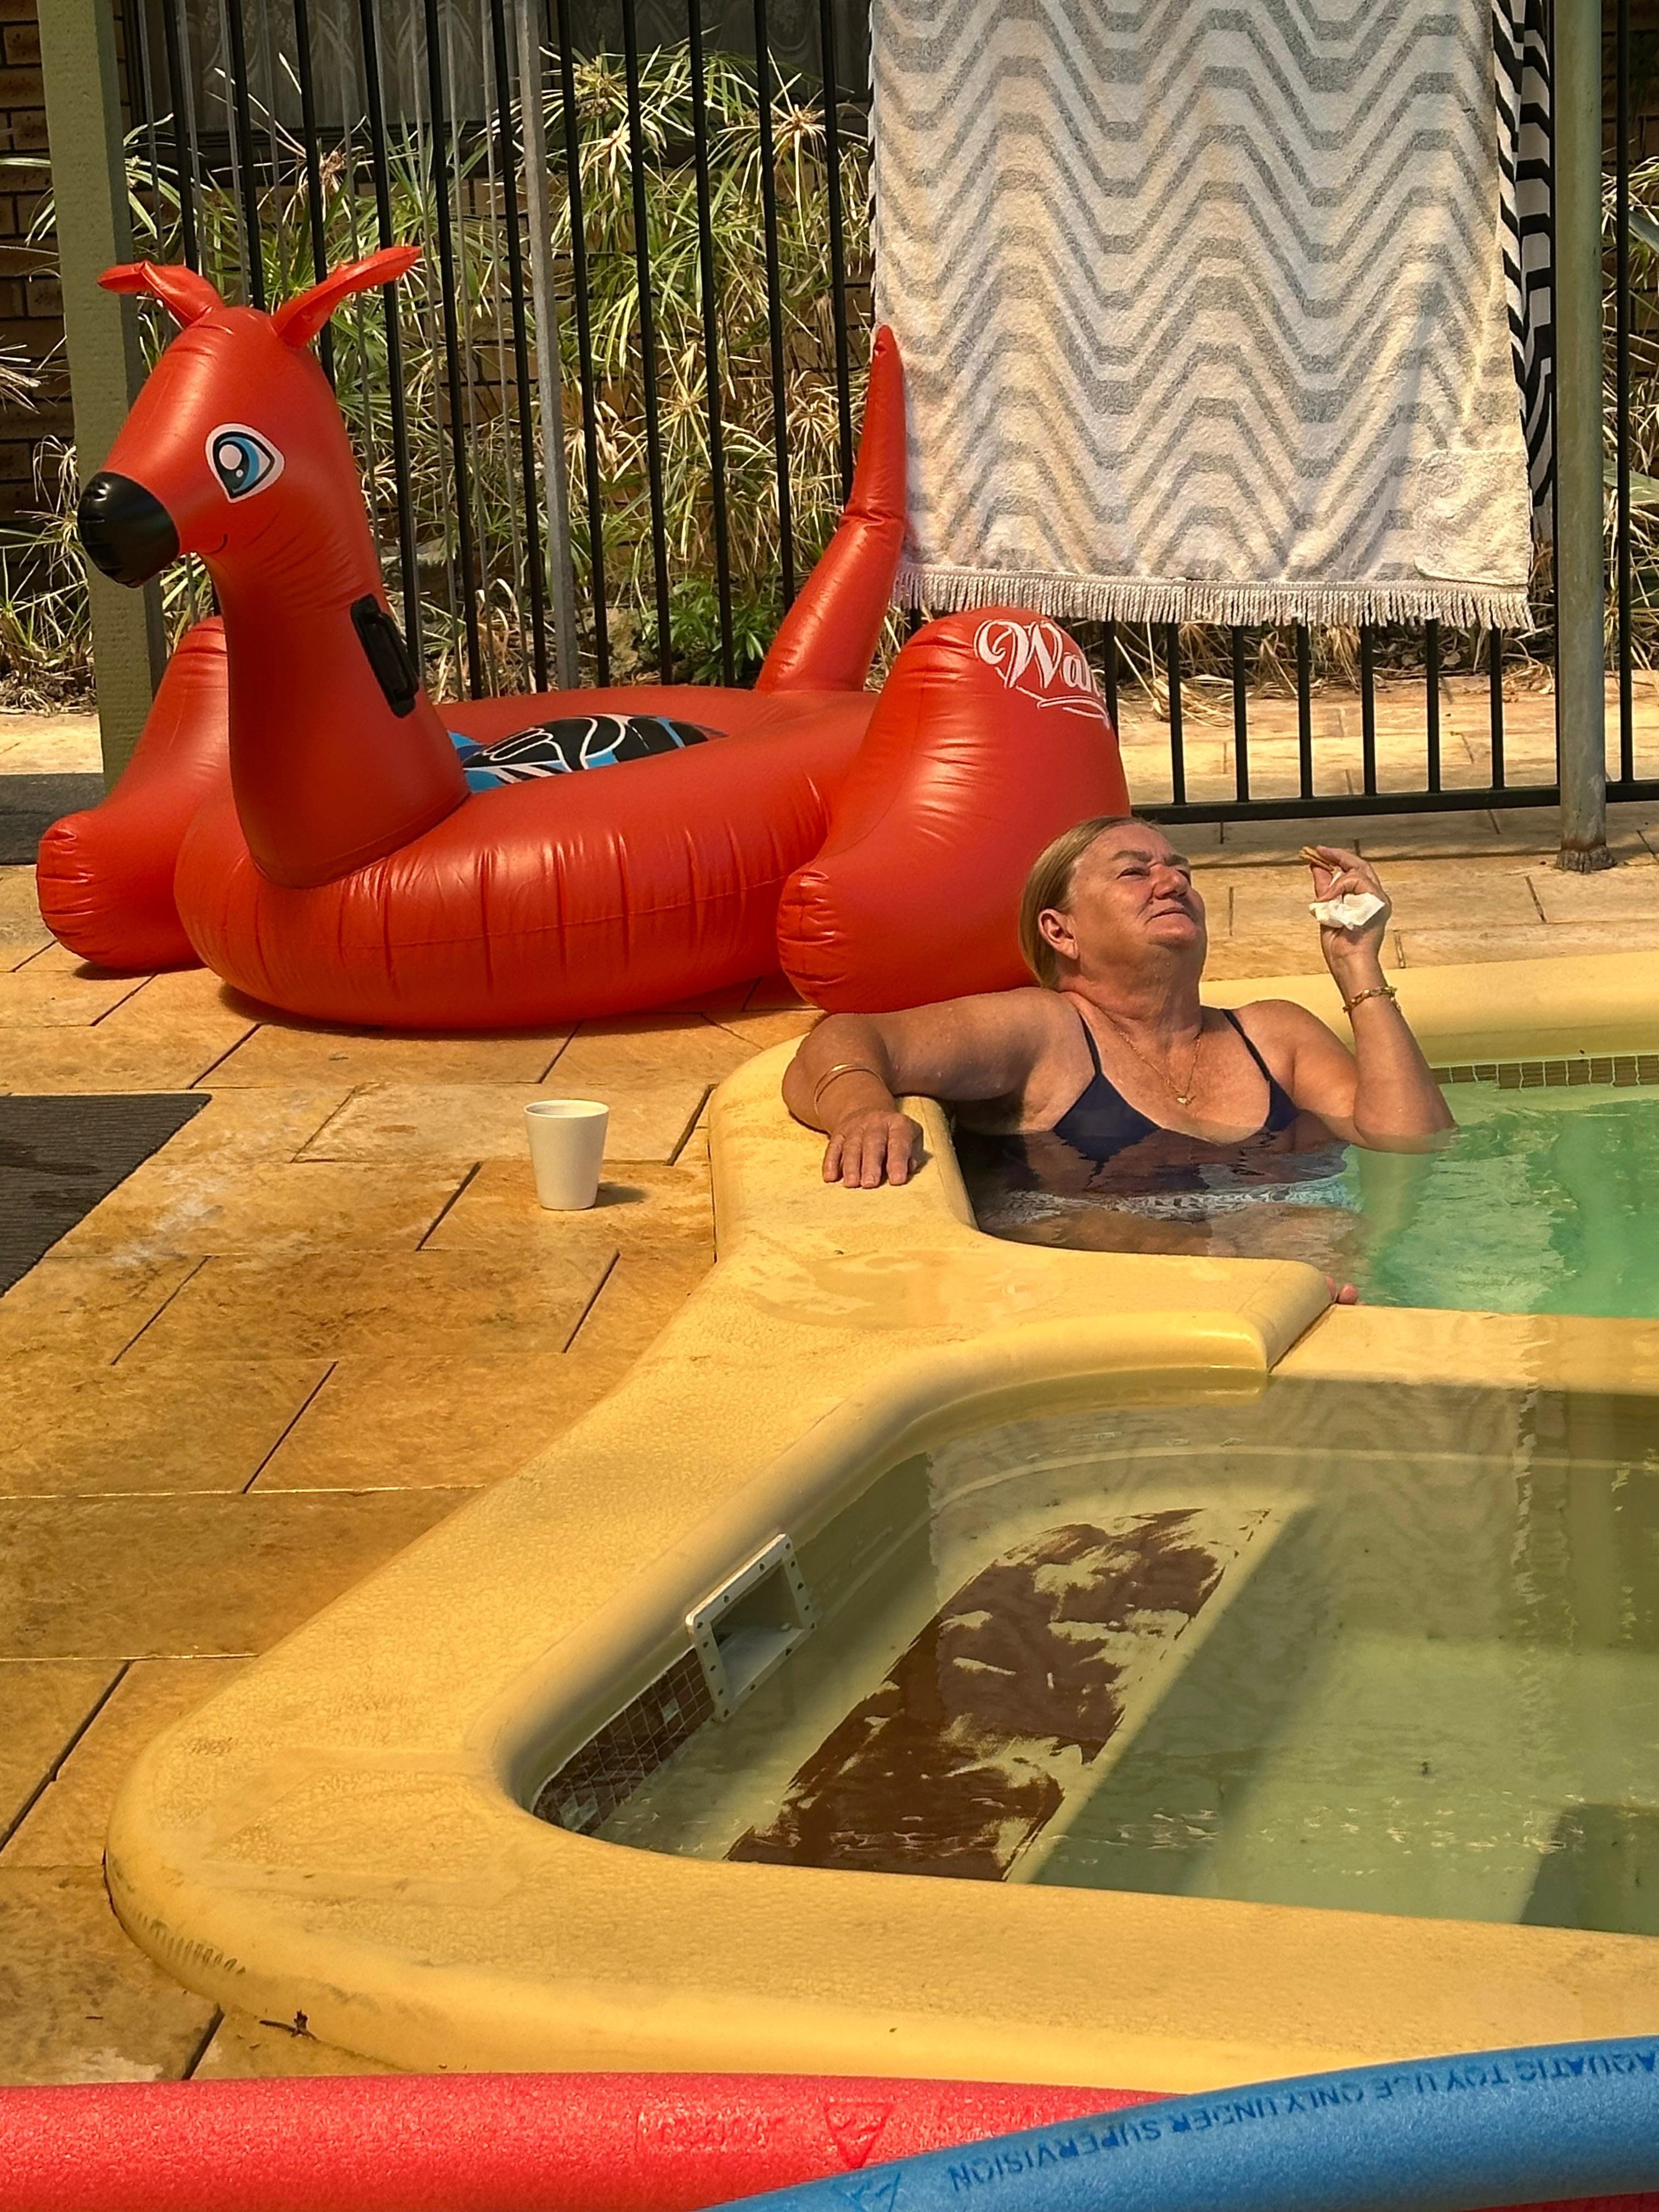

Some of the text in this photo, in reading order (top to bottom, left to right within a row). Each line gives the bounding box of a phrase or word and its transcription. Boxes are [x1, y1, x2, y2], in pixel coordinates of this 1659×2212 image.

[1448, 2061, 1510, 2091] TOY
[1515, 2051, 1656, 2081] AQUATIC
[1288, 2082, 1364, 2113] ONLY
[1168, 2096, 1278, 2133] UNDER
[947, 2119, 1161, 2192] SUPERVISION
